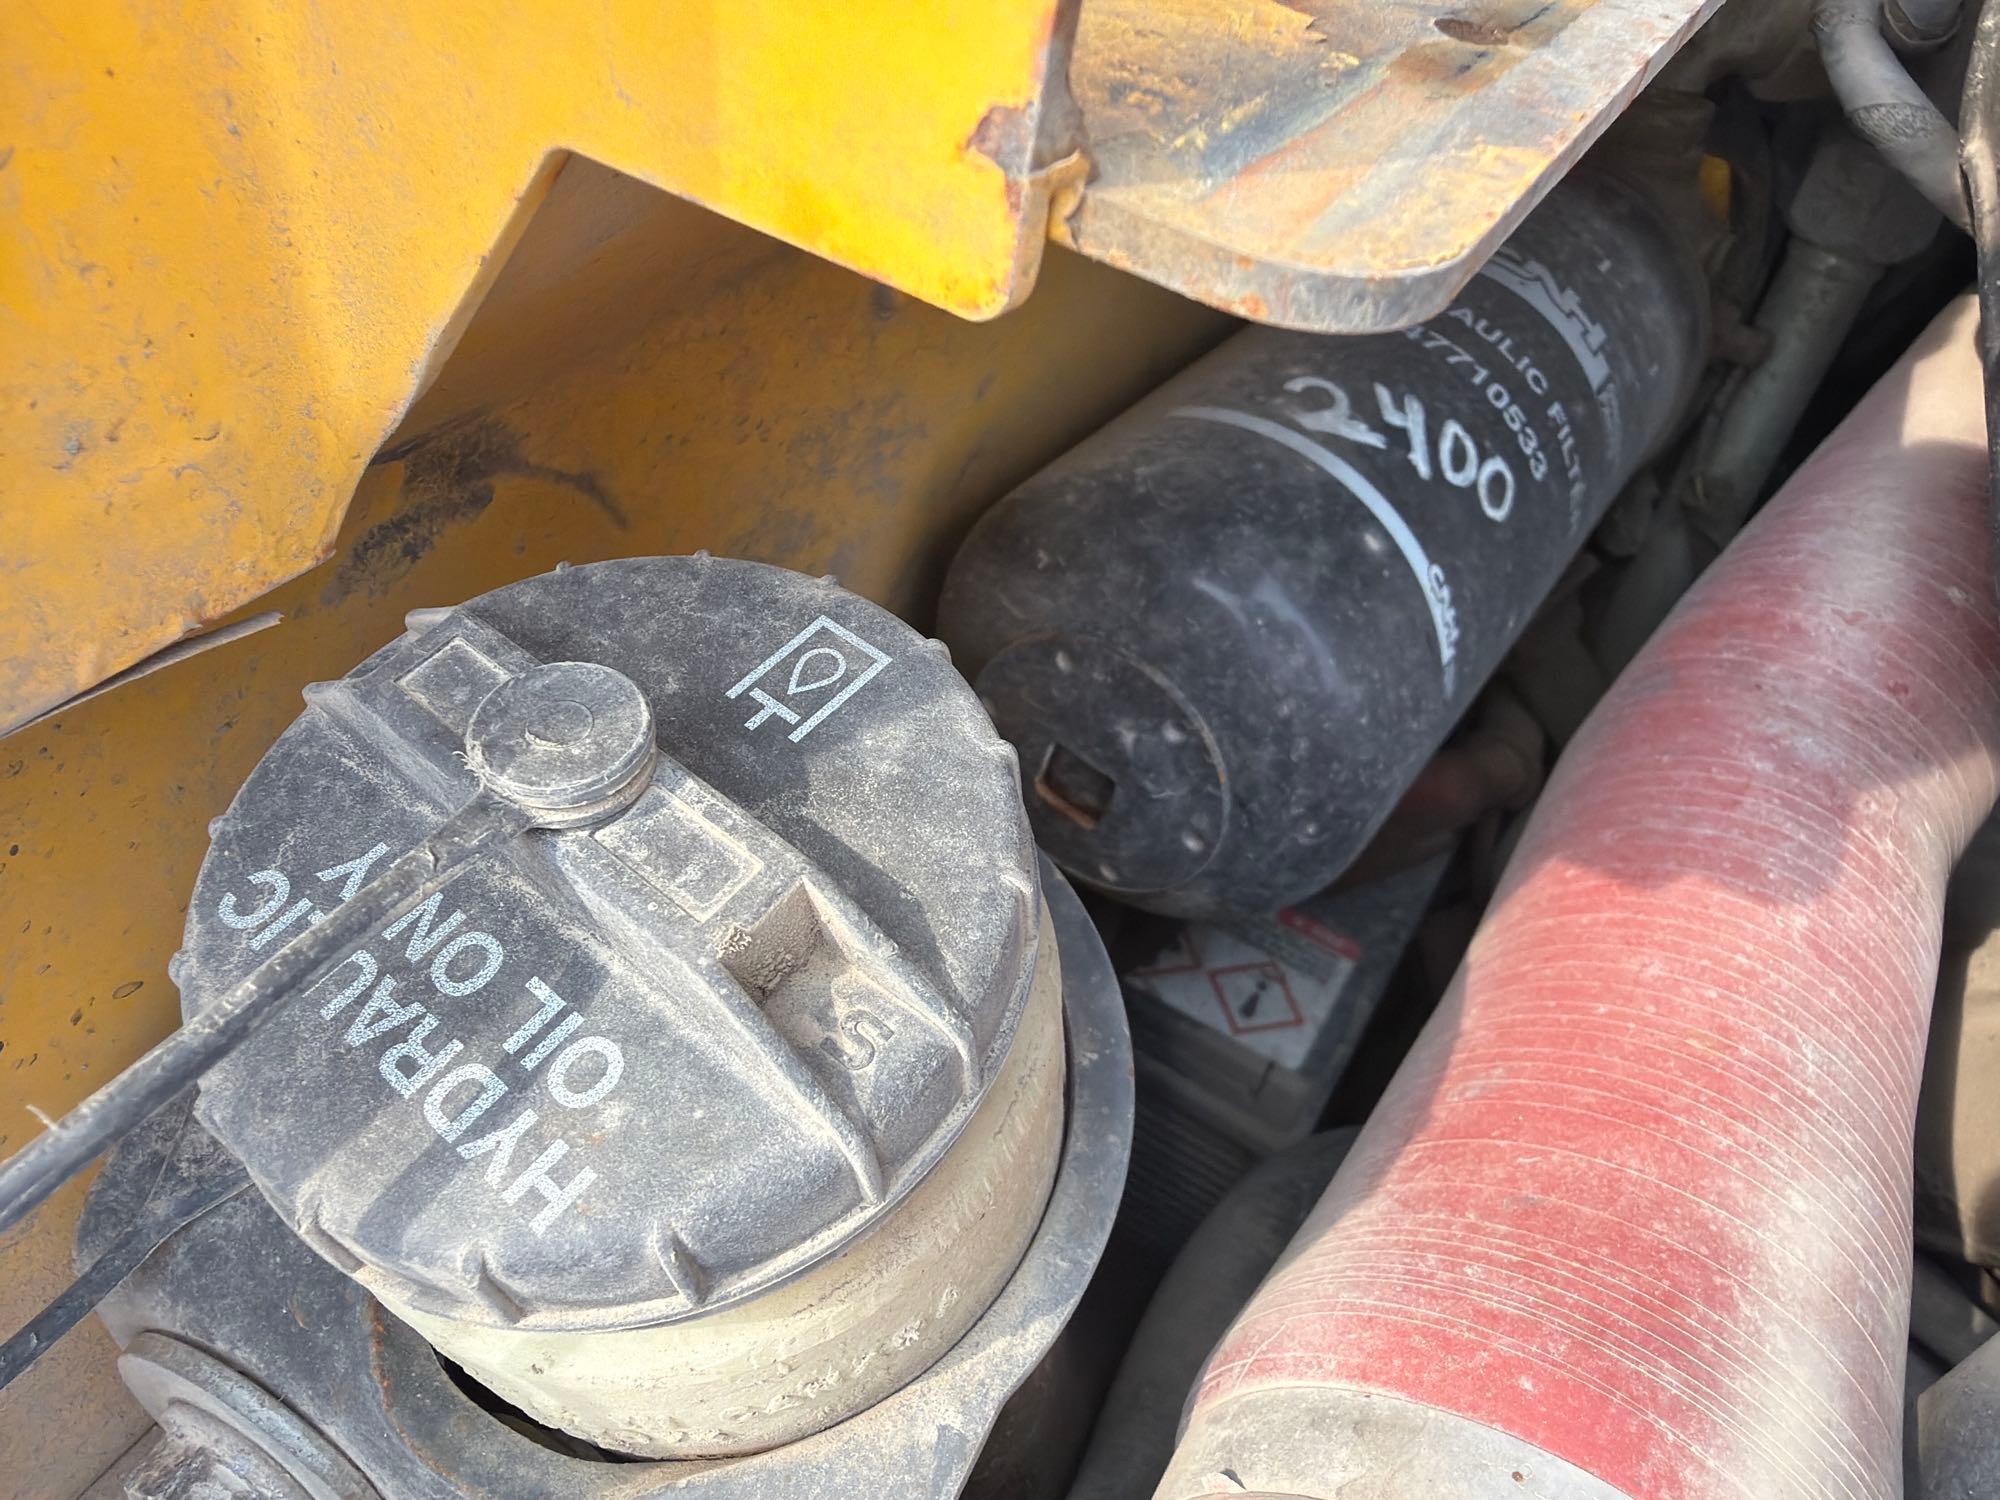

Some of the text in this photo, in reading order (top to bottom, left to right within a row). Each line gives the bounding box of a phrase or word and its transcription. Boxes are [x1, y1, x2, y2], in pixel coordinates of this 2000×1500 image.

[1283, 375, 1515, 522] 2400
[1447, 307, 1548, 395] AULIC
[218, 870, 597, 1237] HYDRAUIC
[315, 841, 625, 1109] OIL ONY
